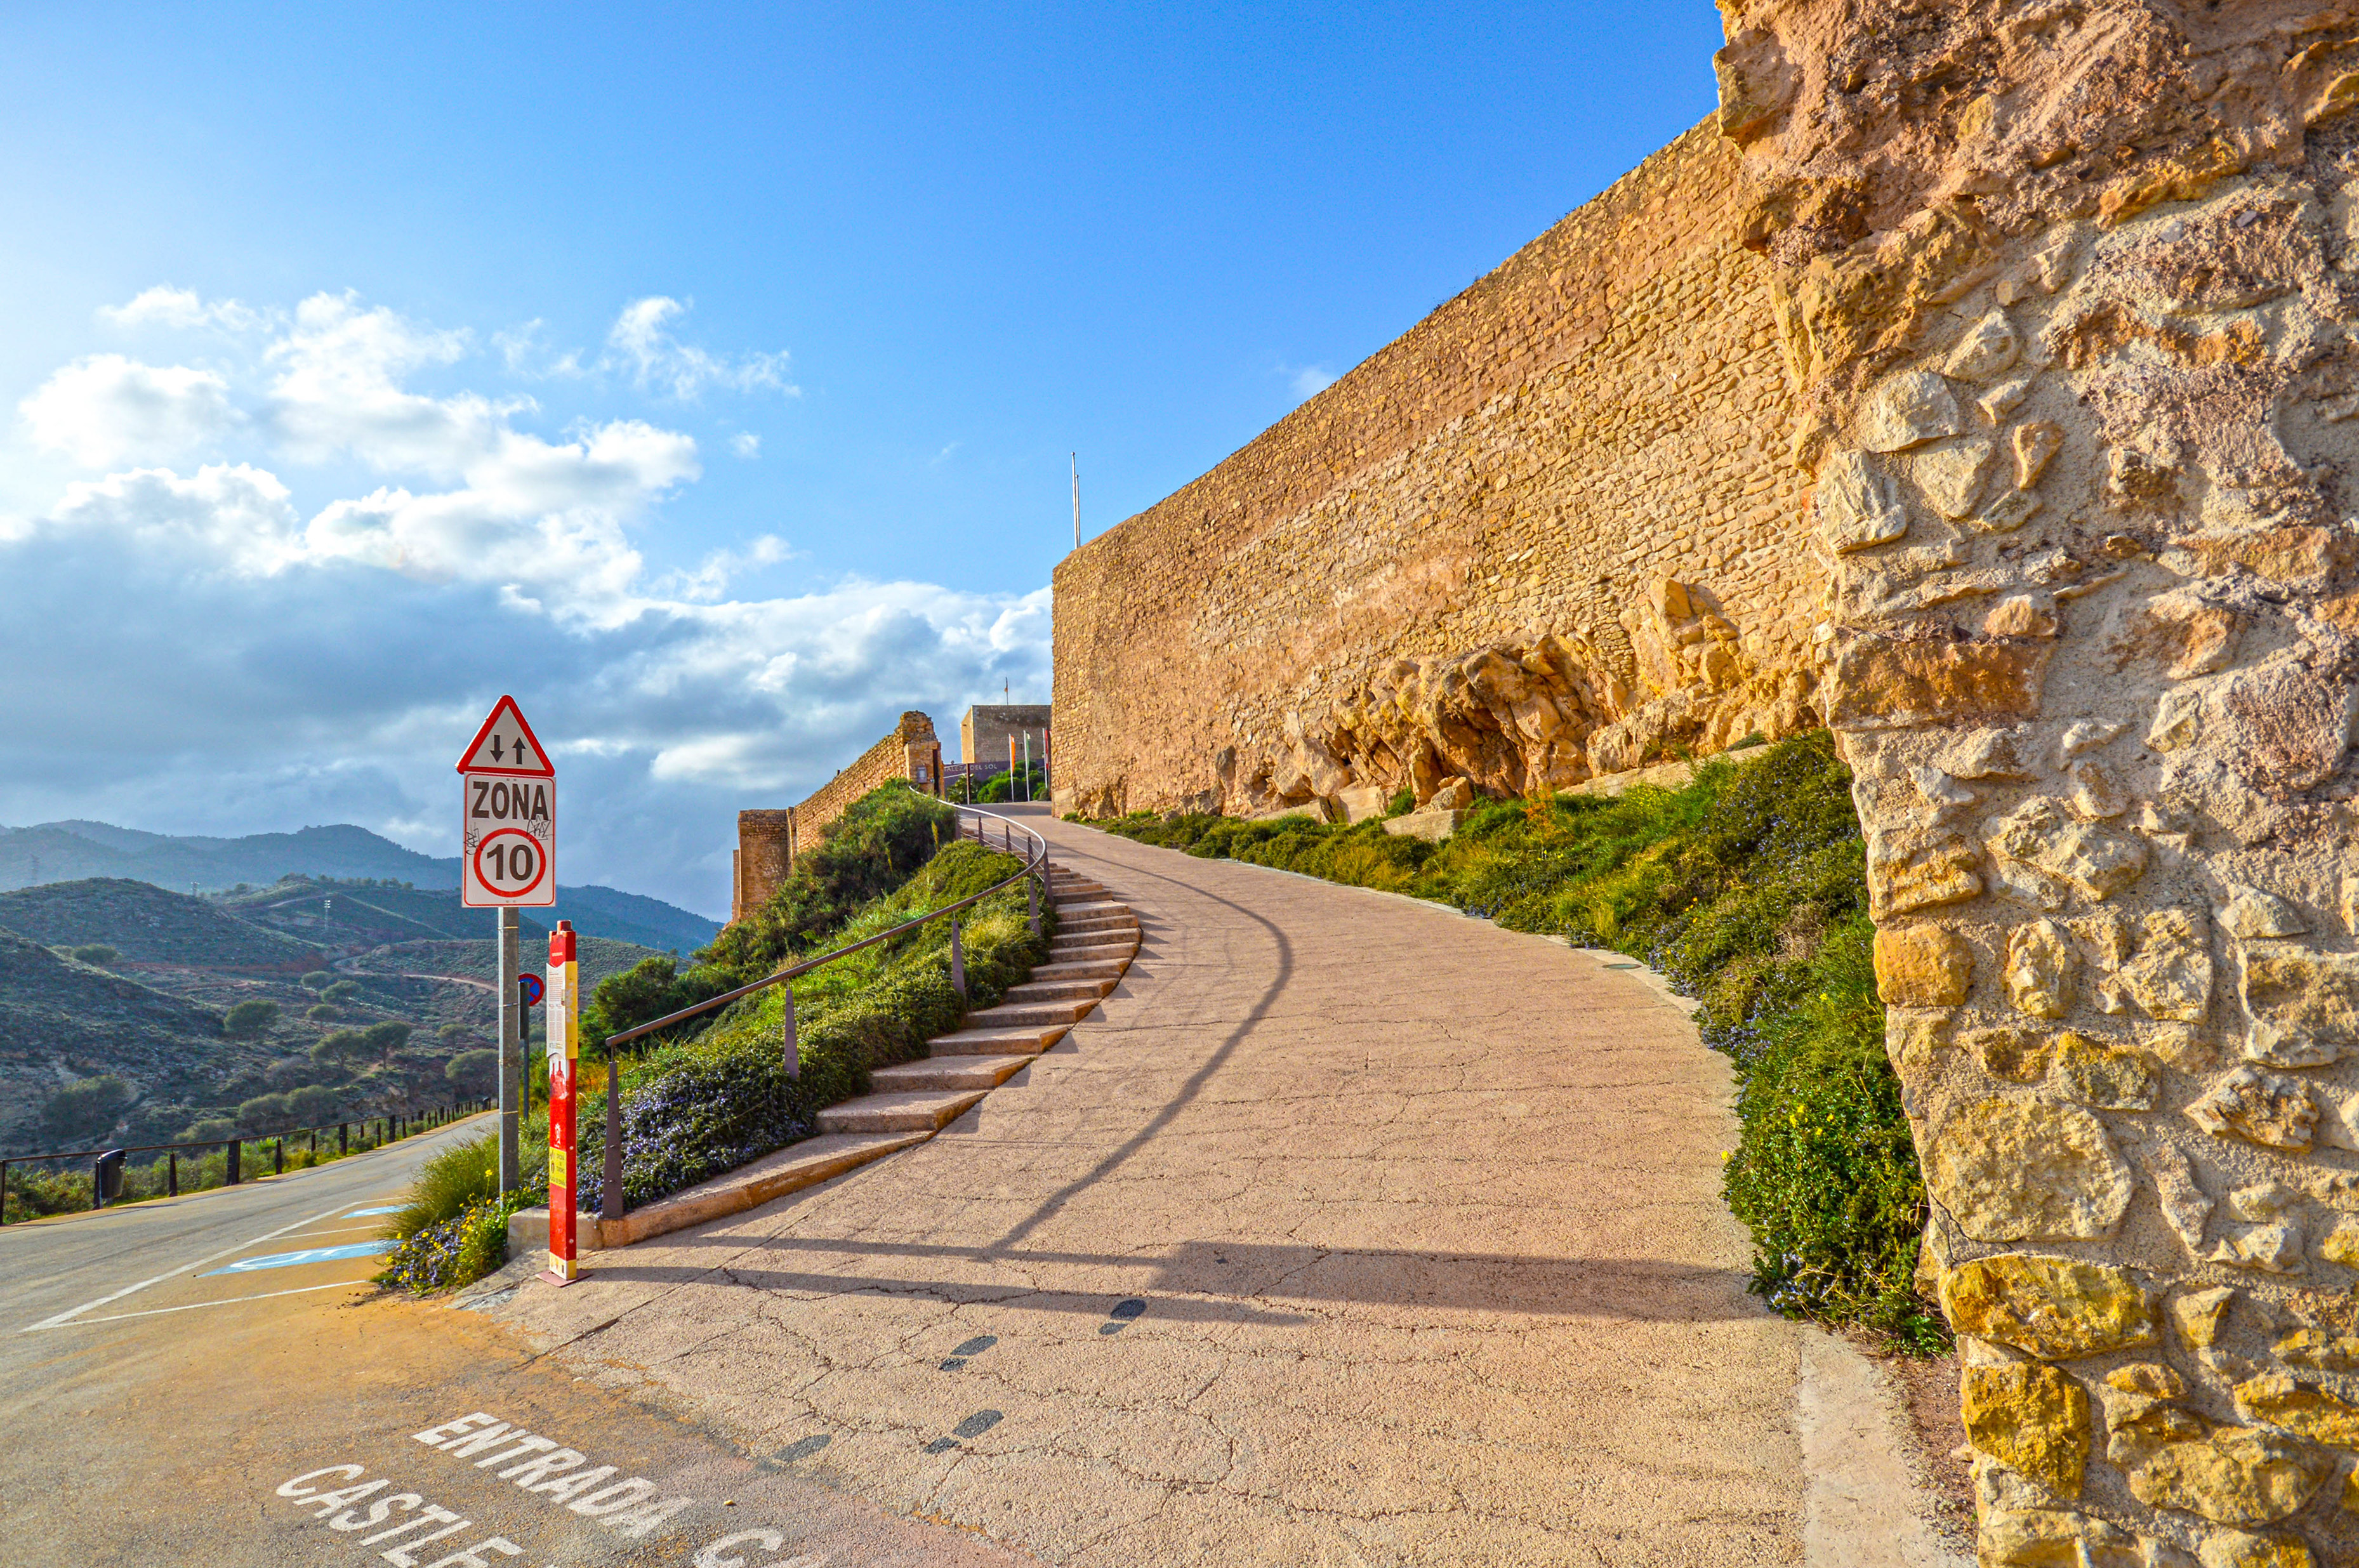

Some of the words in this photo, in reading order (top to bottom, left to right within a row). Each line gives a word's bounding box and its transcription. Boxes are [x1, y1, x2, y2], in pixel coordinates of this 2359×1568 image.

[472, 781, 549, 820] ZONA
[486, 843, 533, 881] 10
[411, 1411, 696, 1539] ENTRADA
[275, 1463, 525, 1568] CASTLE
